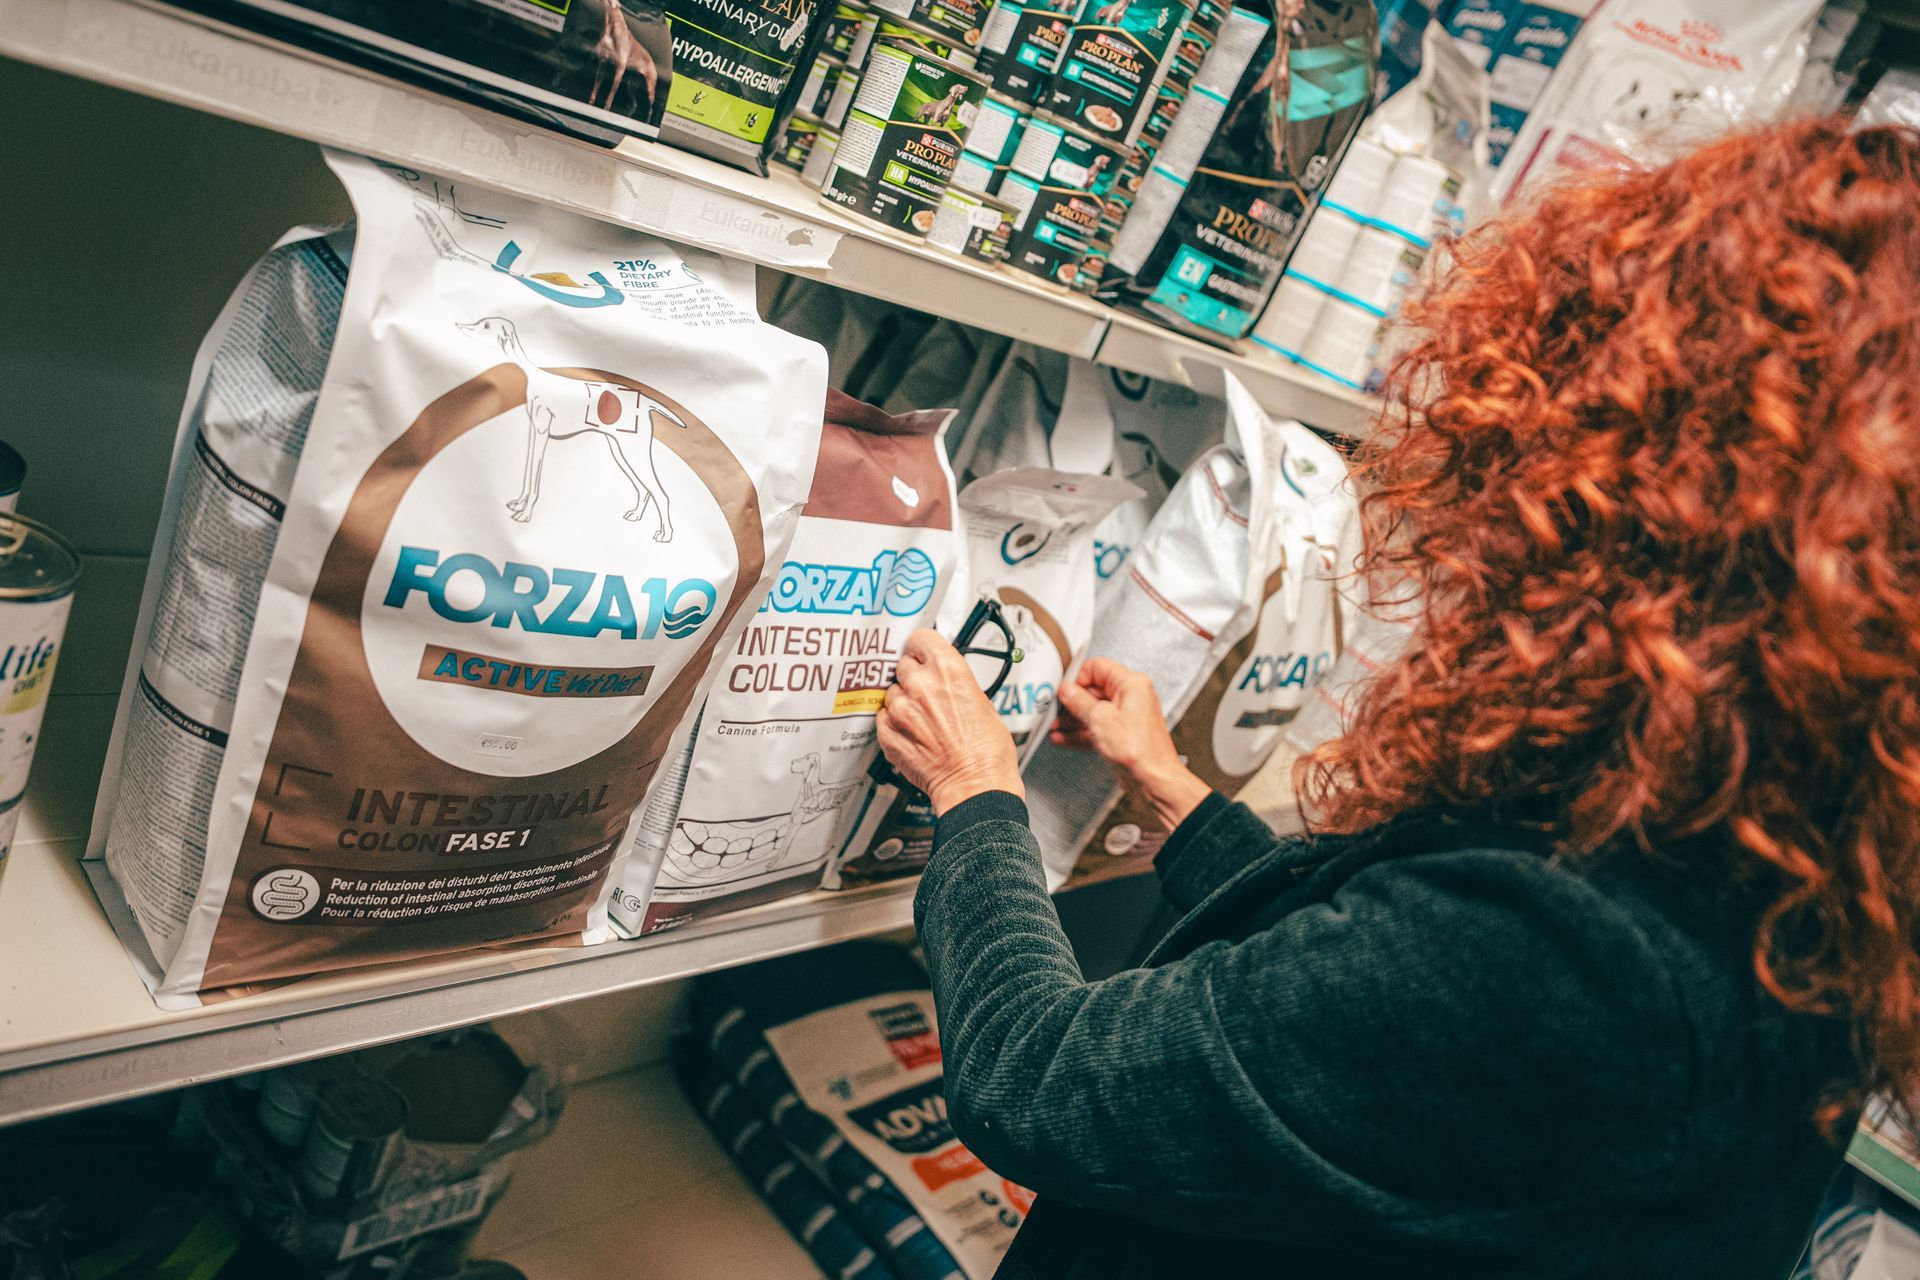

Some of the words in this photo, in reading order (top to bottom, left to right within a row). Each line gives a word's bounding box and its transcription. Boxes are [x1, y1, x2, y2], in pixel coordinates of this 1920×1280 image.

[767, 22, 806, 49] DIS
[672, 37, 783, 96] HYPOALLERGENIC
[1080, 40, 1108, 58] PRO
[1106, 50, 1141, 74] PLAN
[904, 140, 934, 160] PRO
[1212, 204, 1264, 244] PRO
[612, 260, 656, 272] 21%
[619, 270, 671, 280] DIETARY
[623, 280, 660, 289] FIBRE
[670, 297, 697, 306] provide
[684, 303, 711, 312] dietary
[728, 317, 756, 326] healthy
[383, 545, 717, 641] FORZA10
[737, 626, 896, 657] INTESTINAL
[434, 652, 568, 694] ACTIVE
[728, 662, 834, 694] COLON
[839, 660, 896, 690] FASE
[182, 720, 204, 735] FASE
[718, 724, 758, 737] Canine
[760, 724, 800, 736] Formula
[346, 784, 610, 827] INTESTINAL
[338, 828, 441, 852] COLON
[445, 830, 518, 852] FASE
[518, 828, 532, 847] 1
[330, 878, 354, 890] Per
[356, 880, 368, 891] la
[370, 880, 426, 891] riduzione
[428, 878, 446, 890] dei
[447, 874, 489, 888] disturbi
[490, 858, 573, 882] dell'assorbimento
[573, 843, 612, 866] intestinale
[320, 907, 352, 917] Pour
[353, 907, 364, 918] la
[366, 905, 422, 919] réduction
[424, 904, 438, 915] du
[440, 901, 473, 914] risque
[474, 898, 486, 908] de
[489, 884, 554, 906] malabsorption
[555, 870, 598, 892] intestinale
[326, 893, 388, 905] Reduction
[390, 894, 404, 905] of
[404, 890, 457, 904] intestinal
[458, 884, 512, 900] absorption
[512, 874, 556, 890] disorders
